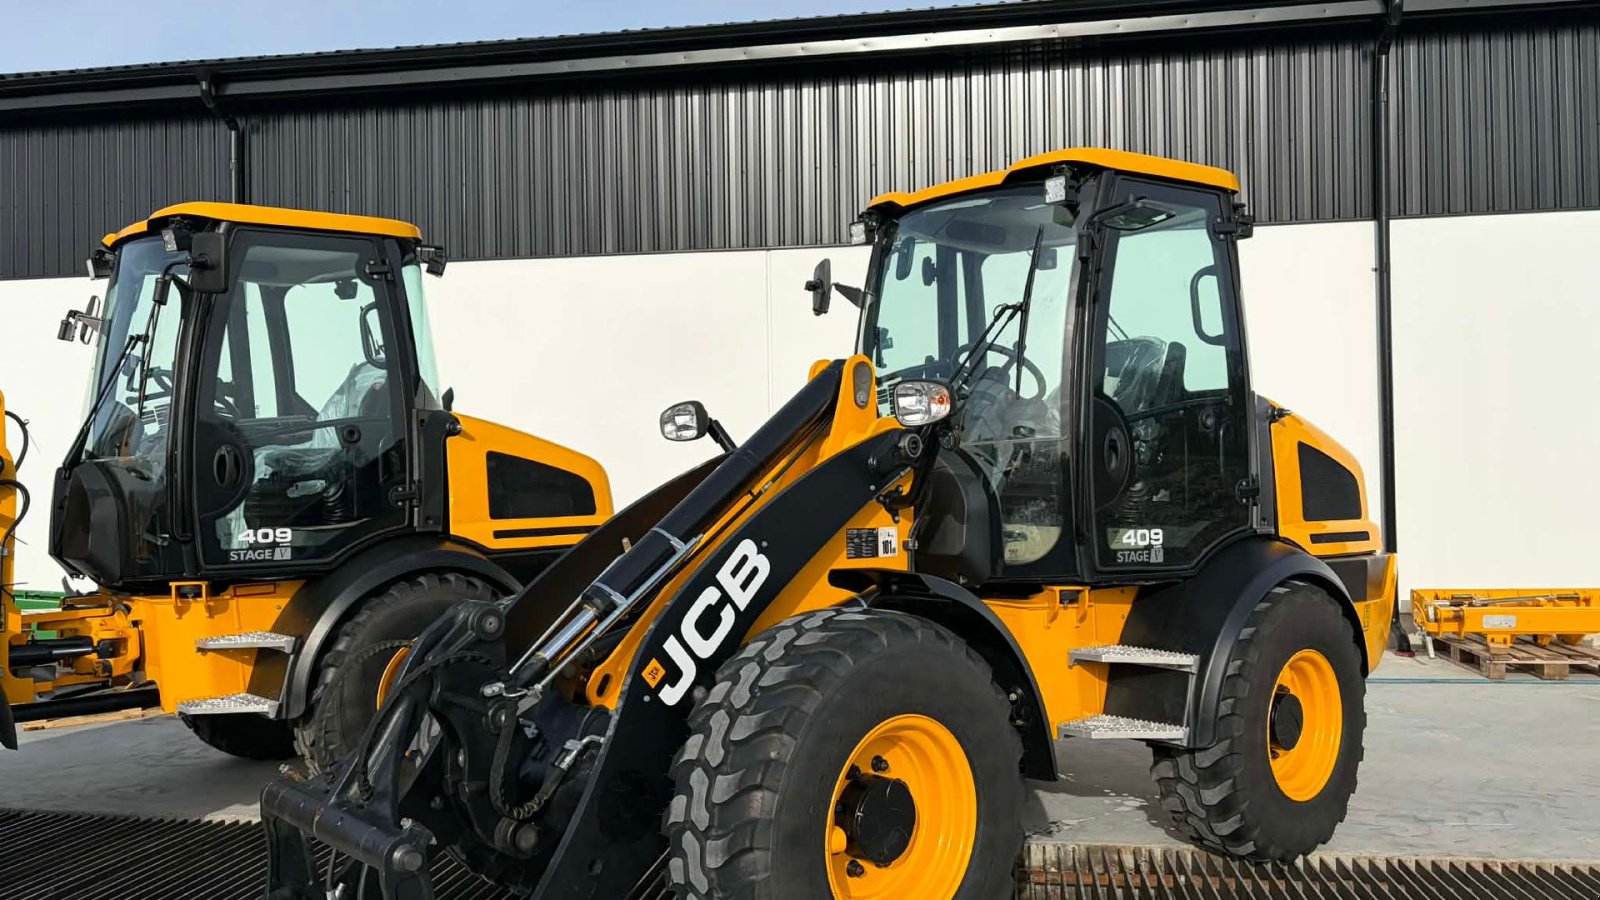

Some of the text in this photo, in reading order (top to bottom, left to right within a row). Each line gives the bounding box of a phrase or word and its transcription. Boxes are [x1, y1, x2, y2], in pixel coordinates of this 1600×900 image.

[238, 528, 292, 544] 409
[1122, 528, 1163, 546] 409
[229, 549, 273, 561] STAGE
[1117, 550, 1149, 563] STAGE
[658, 538, 771, 707] JCB
